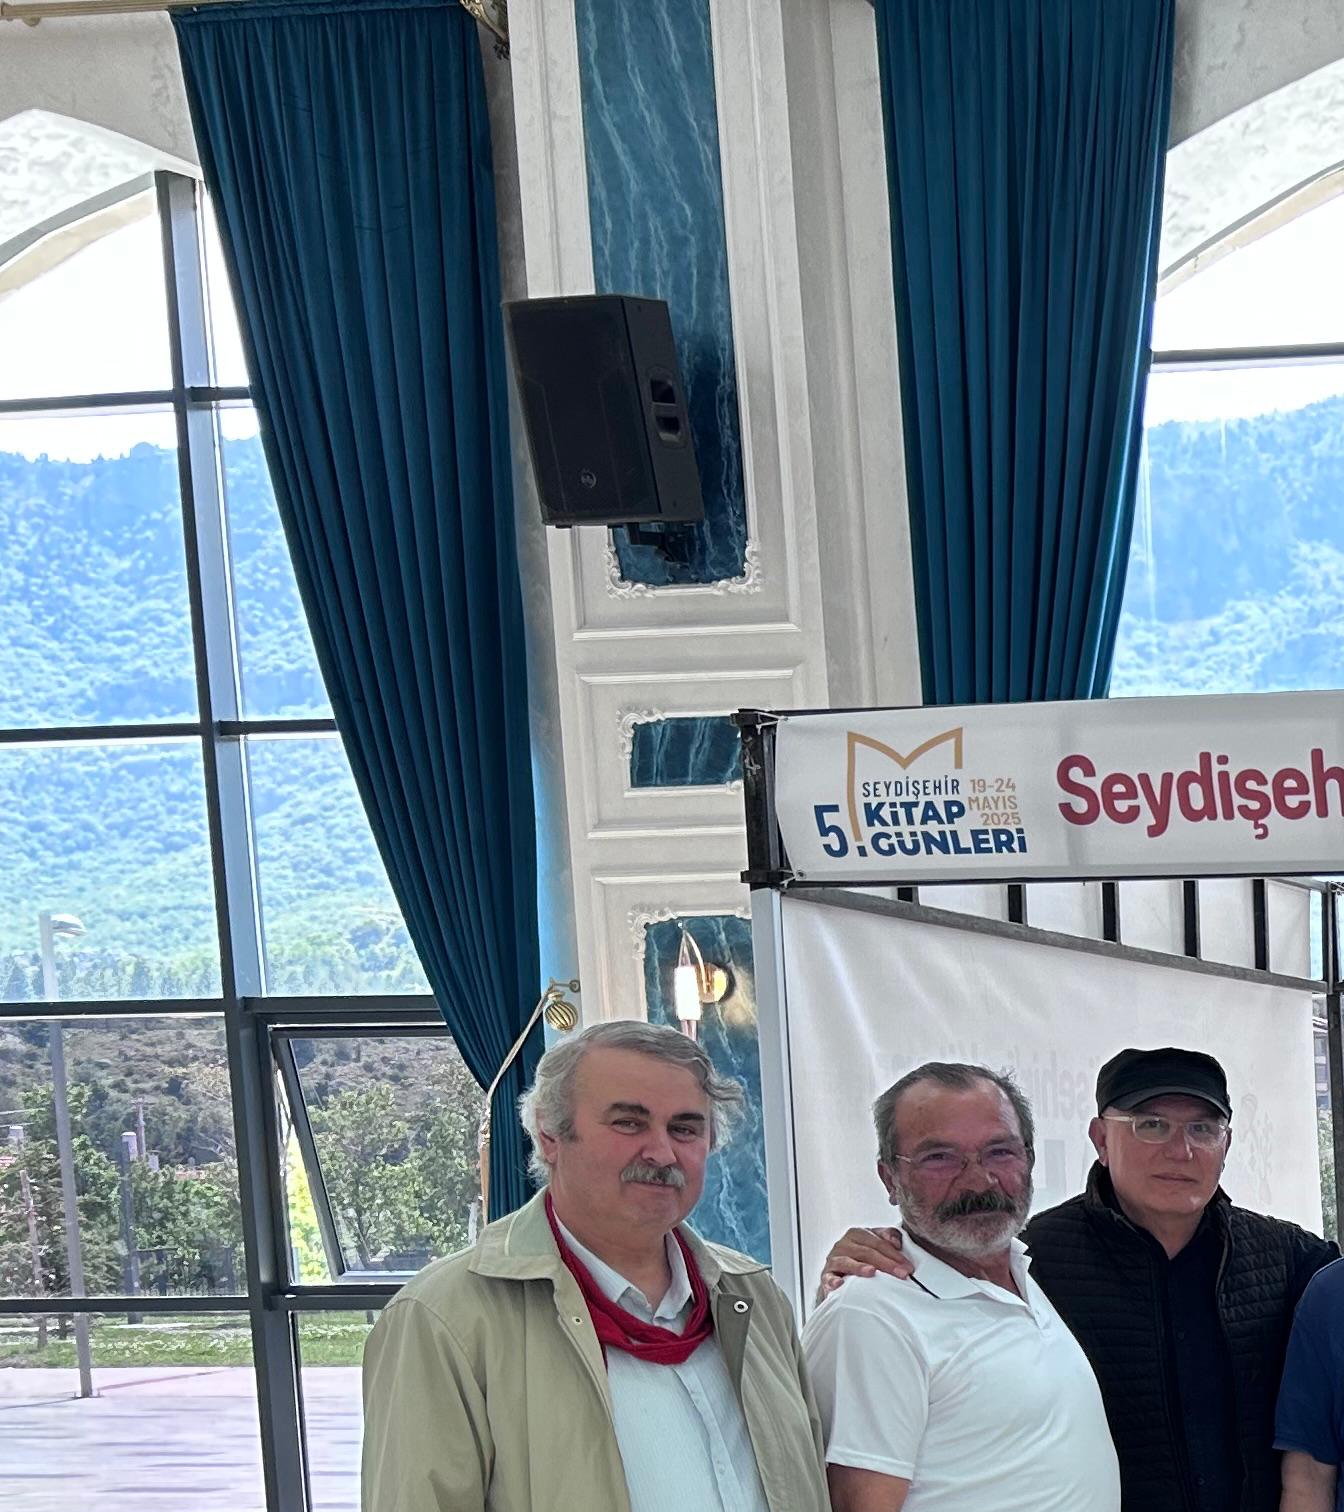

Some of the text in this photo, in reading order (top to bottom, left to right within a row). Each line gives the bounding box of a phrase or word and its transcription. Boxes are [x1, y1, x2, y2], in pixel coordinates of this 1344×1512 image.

[862, 774, 960, 799] SEYDİŞEHİR
[969, 778, 1016, 794] 19-24
[968, 795, 1018, 811] MAYIS
[980, 812, 1021, 826] 2025
